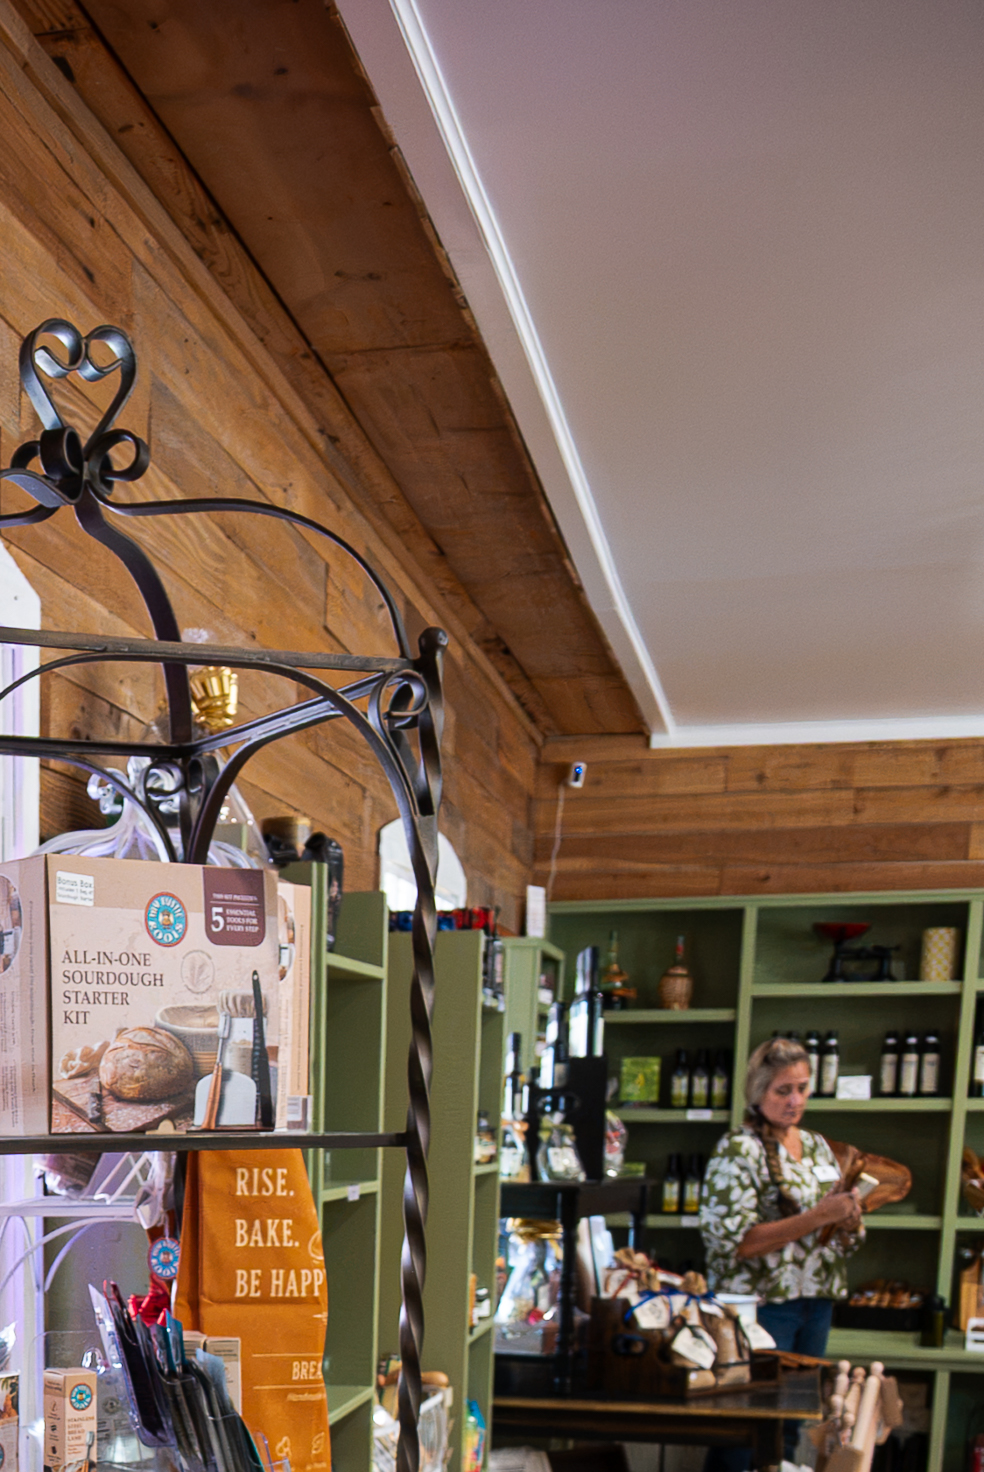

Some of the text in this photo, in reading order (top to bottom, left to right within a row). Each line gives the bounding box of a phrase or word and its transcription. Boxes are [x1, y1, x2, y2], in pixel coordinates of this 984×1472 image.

[210, 906, 225, 932] 5
[61, 950, 152, 966] ALL-IN-ONE
[62, 970, 164, 987] SOURDOUGH
[62, 990, 130, 1006] STARTER
[63, 1010, 90, 1024] KIT
[236, 1167, 294, 1196] RISE.
[234, 1218, 300, 1248] BAKE.
[234, 1268, 325, 1298] BE HAPP
